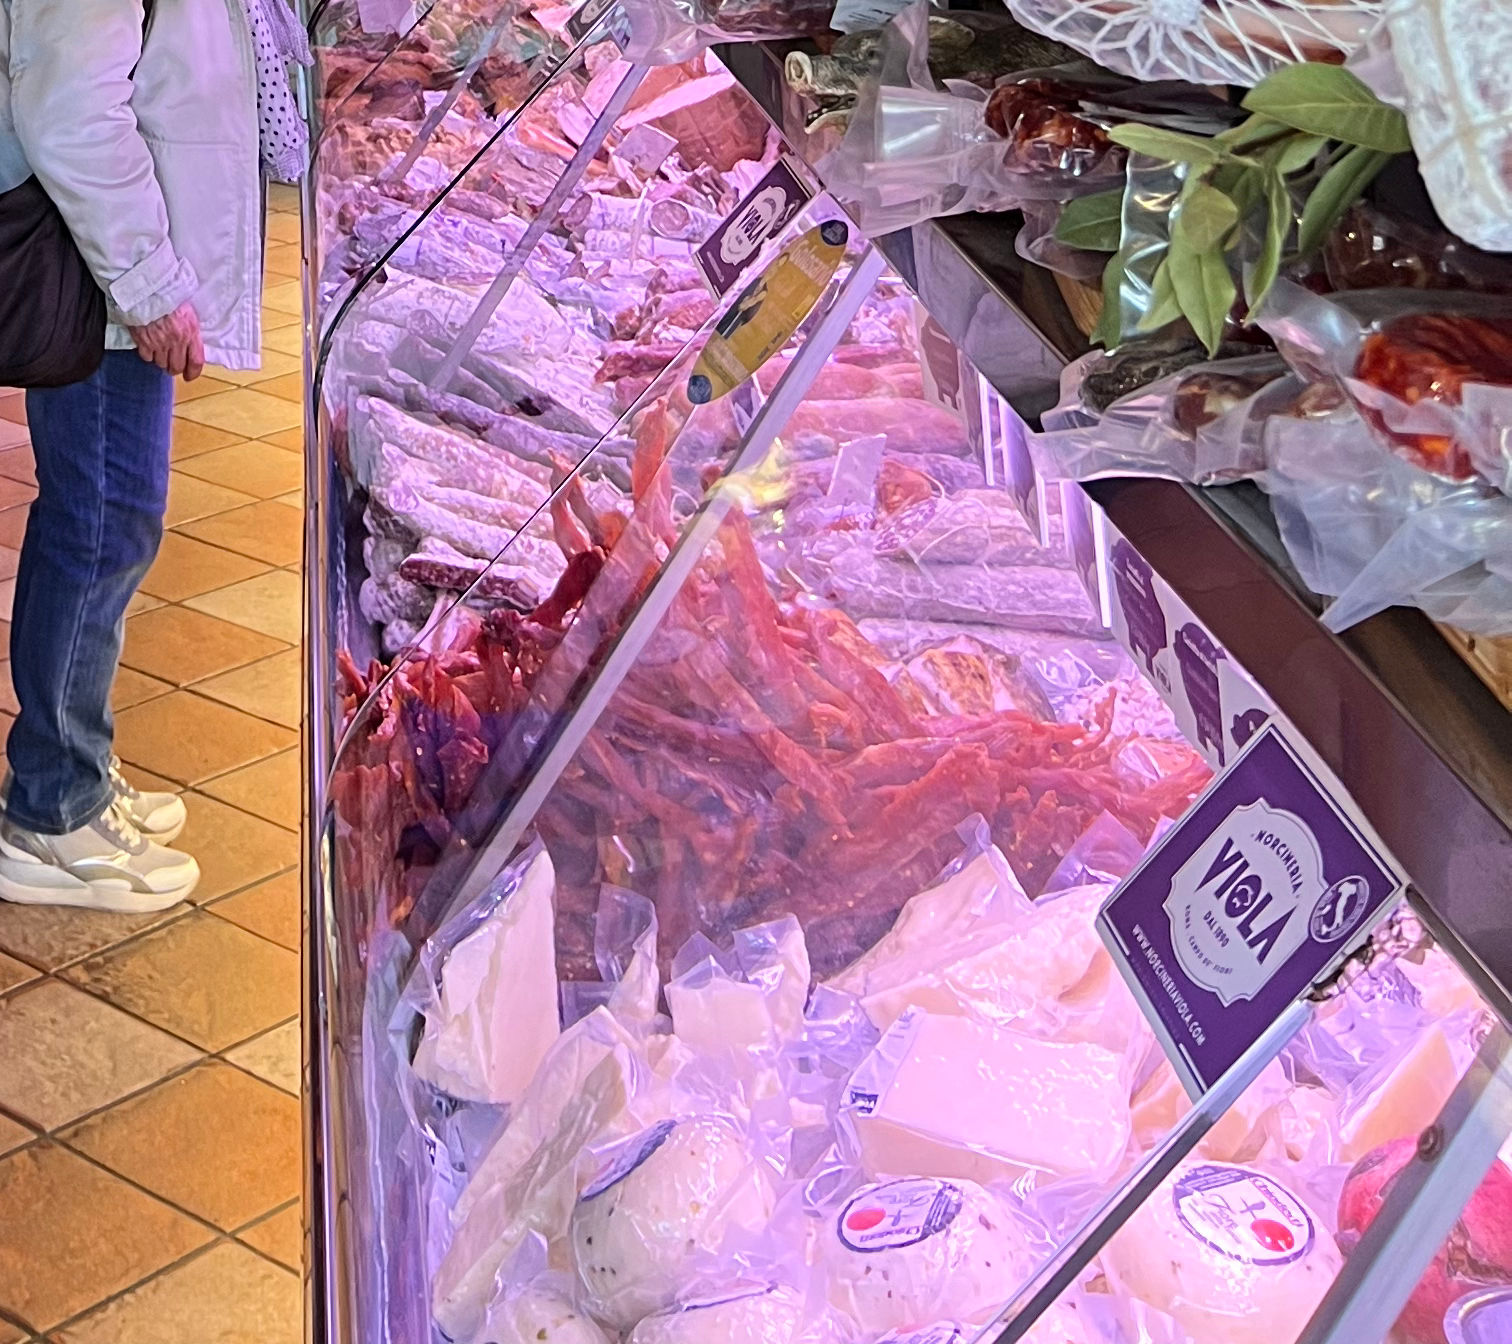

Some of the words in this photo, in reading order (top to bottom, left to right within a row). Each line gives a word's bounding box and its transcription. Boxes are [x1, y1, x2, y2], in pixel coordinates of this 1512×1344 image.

[1194, 837, 1297, 965] VIOLA
[1255, 830, 1303, 894] NORCINERIA
[1202, 910, 1213, 931] DAL
[1213, 927, 1230, 948] 1890
[1132, 924, 1206, 1046] WWW.NORCINERIAVIOLA.COM
